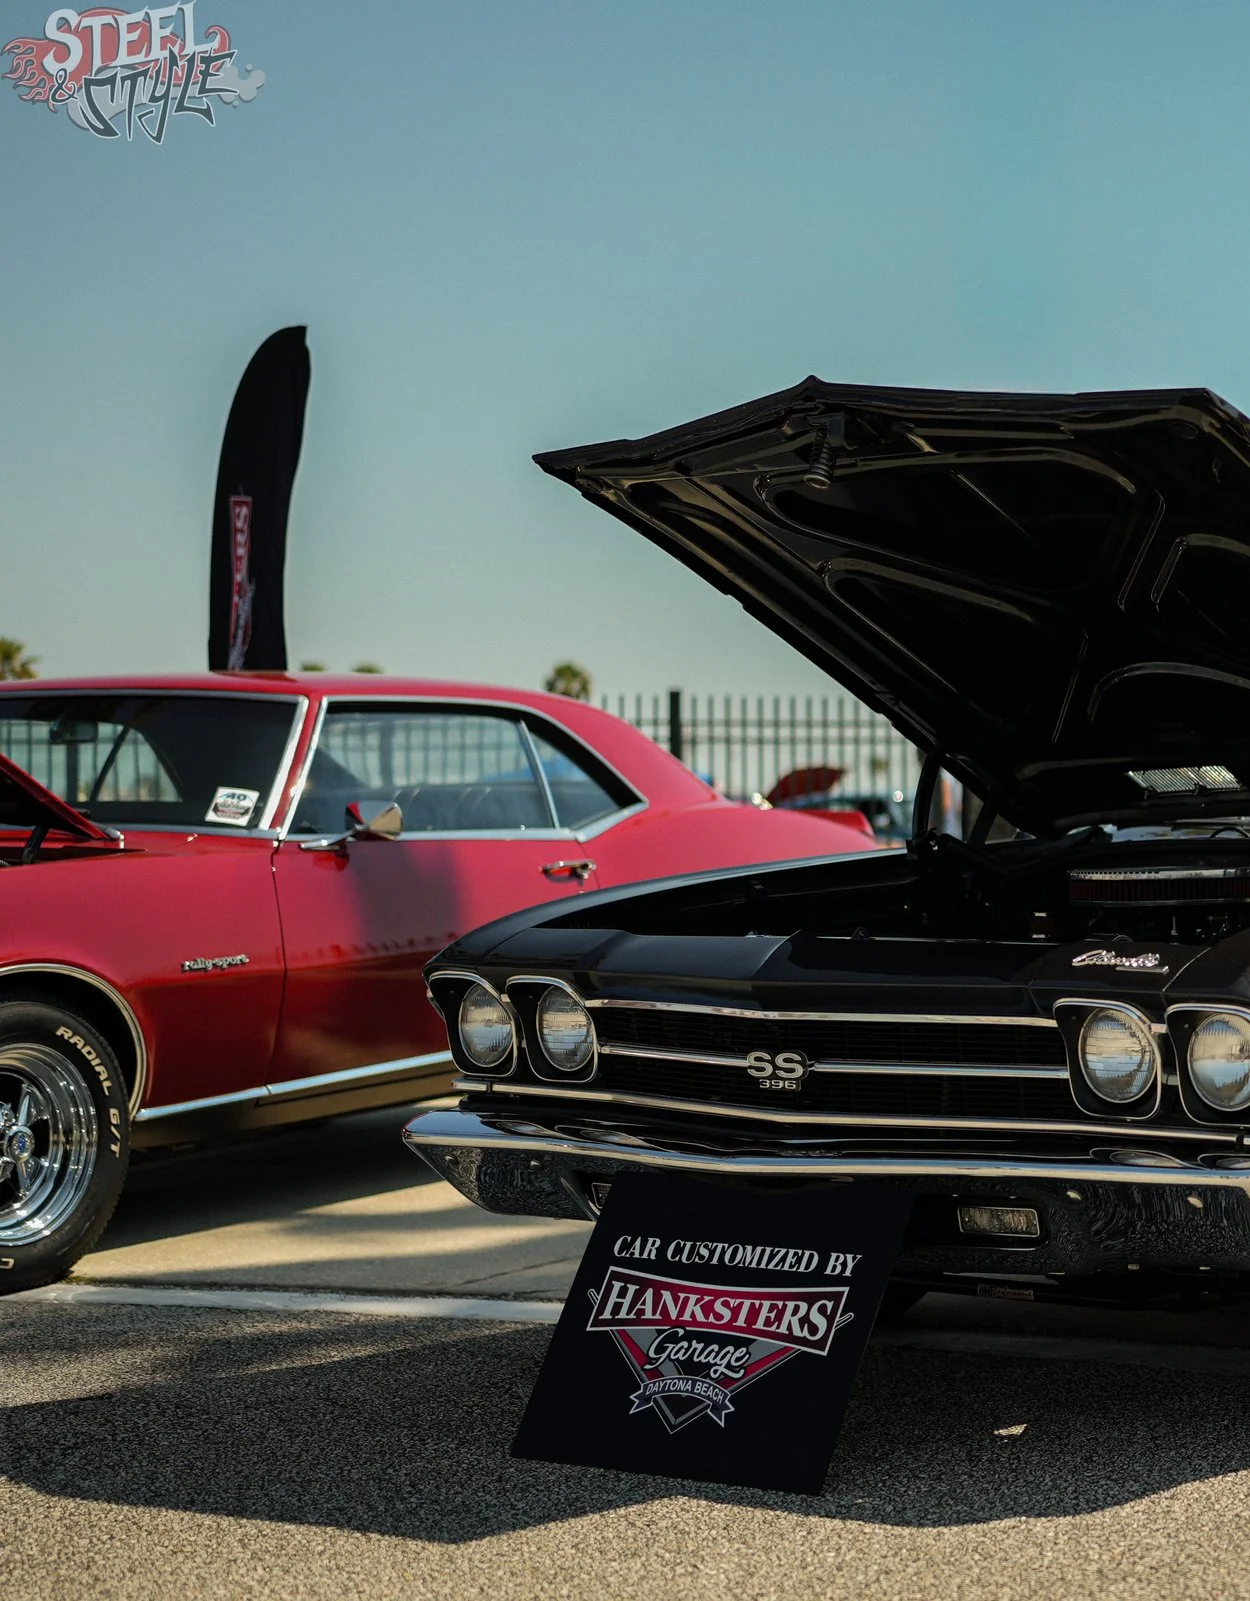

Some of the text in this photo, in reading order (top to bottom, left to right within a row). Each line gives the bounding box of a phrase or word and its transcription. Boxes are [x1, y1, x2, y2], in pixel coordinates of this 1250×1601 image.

[746, 1051, 804, 1079] SS
[759, 1079, 797, 1090] 396
[56, 1026, 121, 1159] RADIAL G/T
[613, 1235, 862, 1277] CAR CUSTOMIZED BY
[599, 1280, 835, 1341] HANKSTERS
[643, 1328, 750, 1379] Garage
[645, 1380, 725, 1404] DAYTONA BEACH
